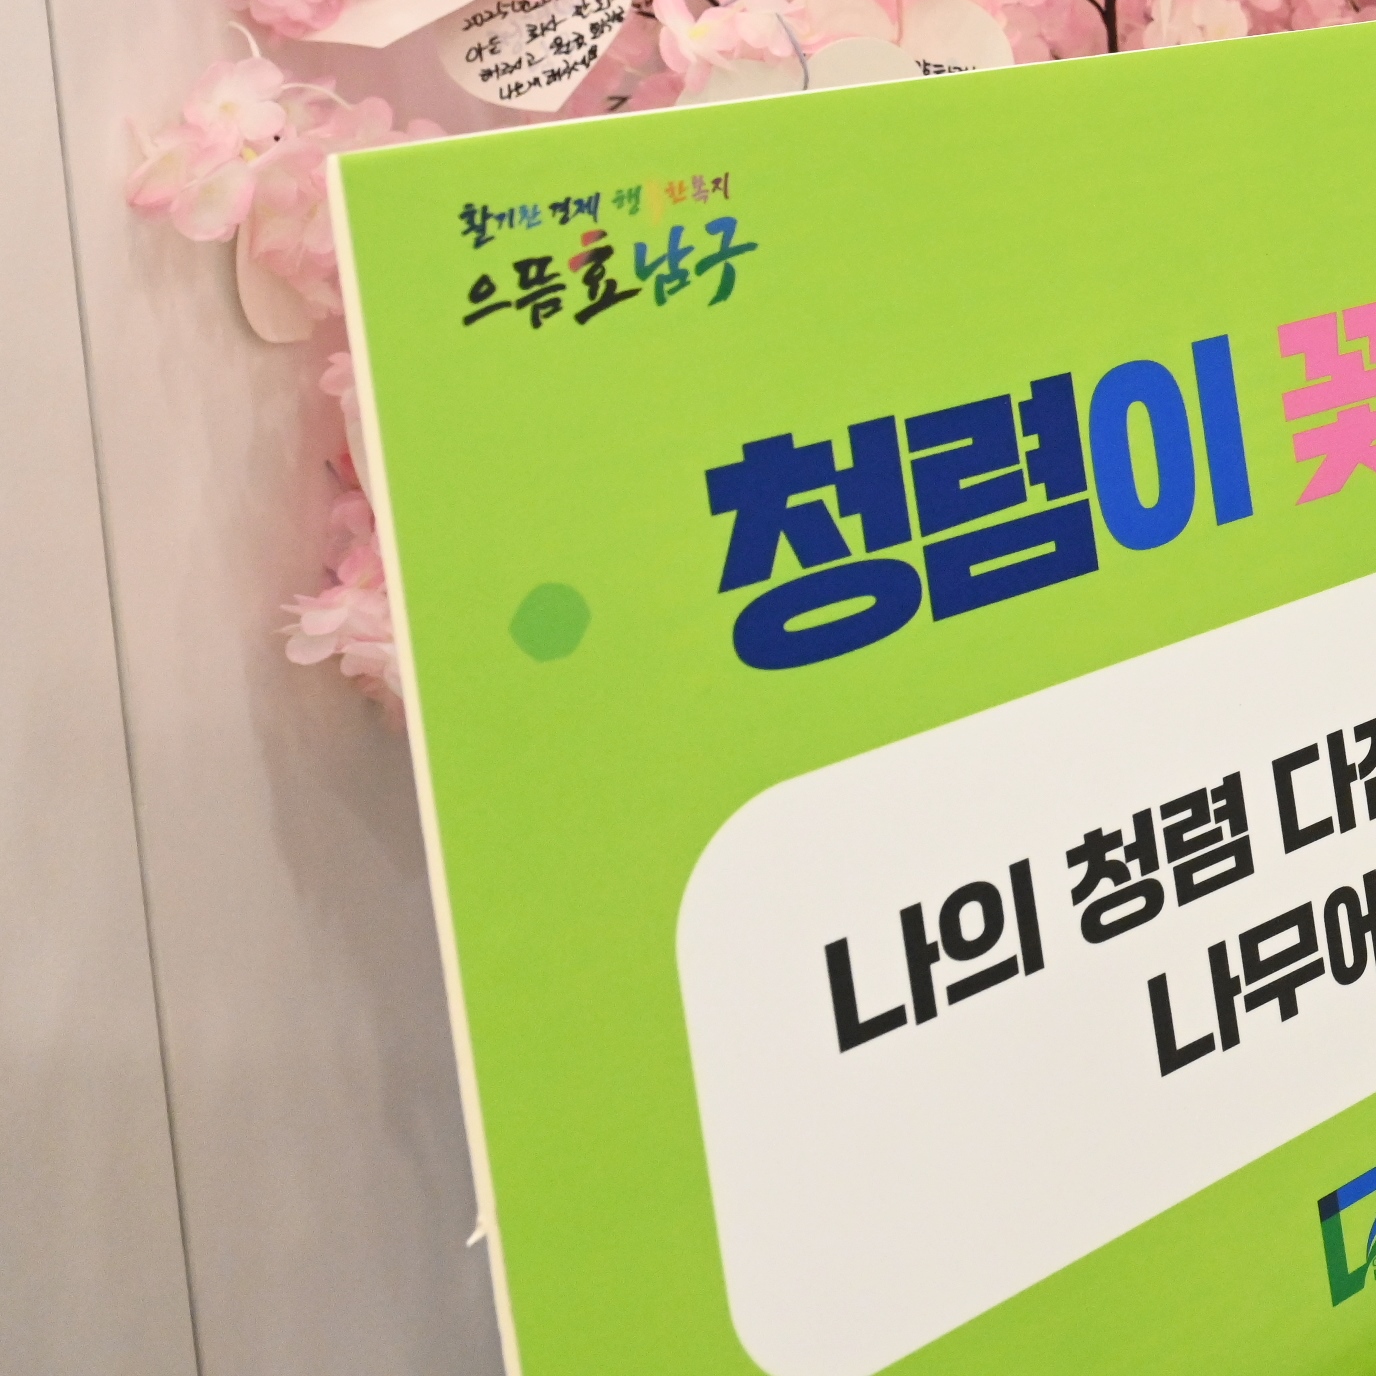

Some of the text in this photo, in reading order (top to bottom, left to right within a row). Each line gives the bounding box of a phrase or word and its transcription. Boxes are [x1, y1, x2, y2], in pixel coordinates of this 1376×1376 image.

[548, 191, 601, 226] 경제
[706, 337, 1254, 671] 청렴이
[825, 862, 1045, 1053] 나의
[1066, 772, 1255, 944] 청렴
